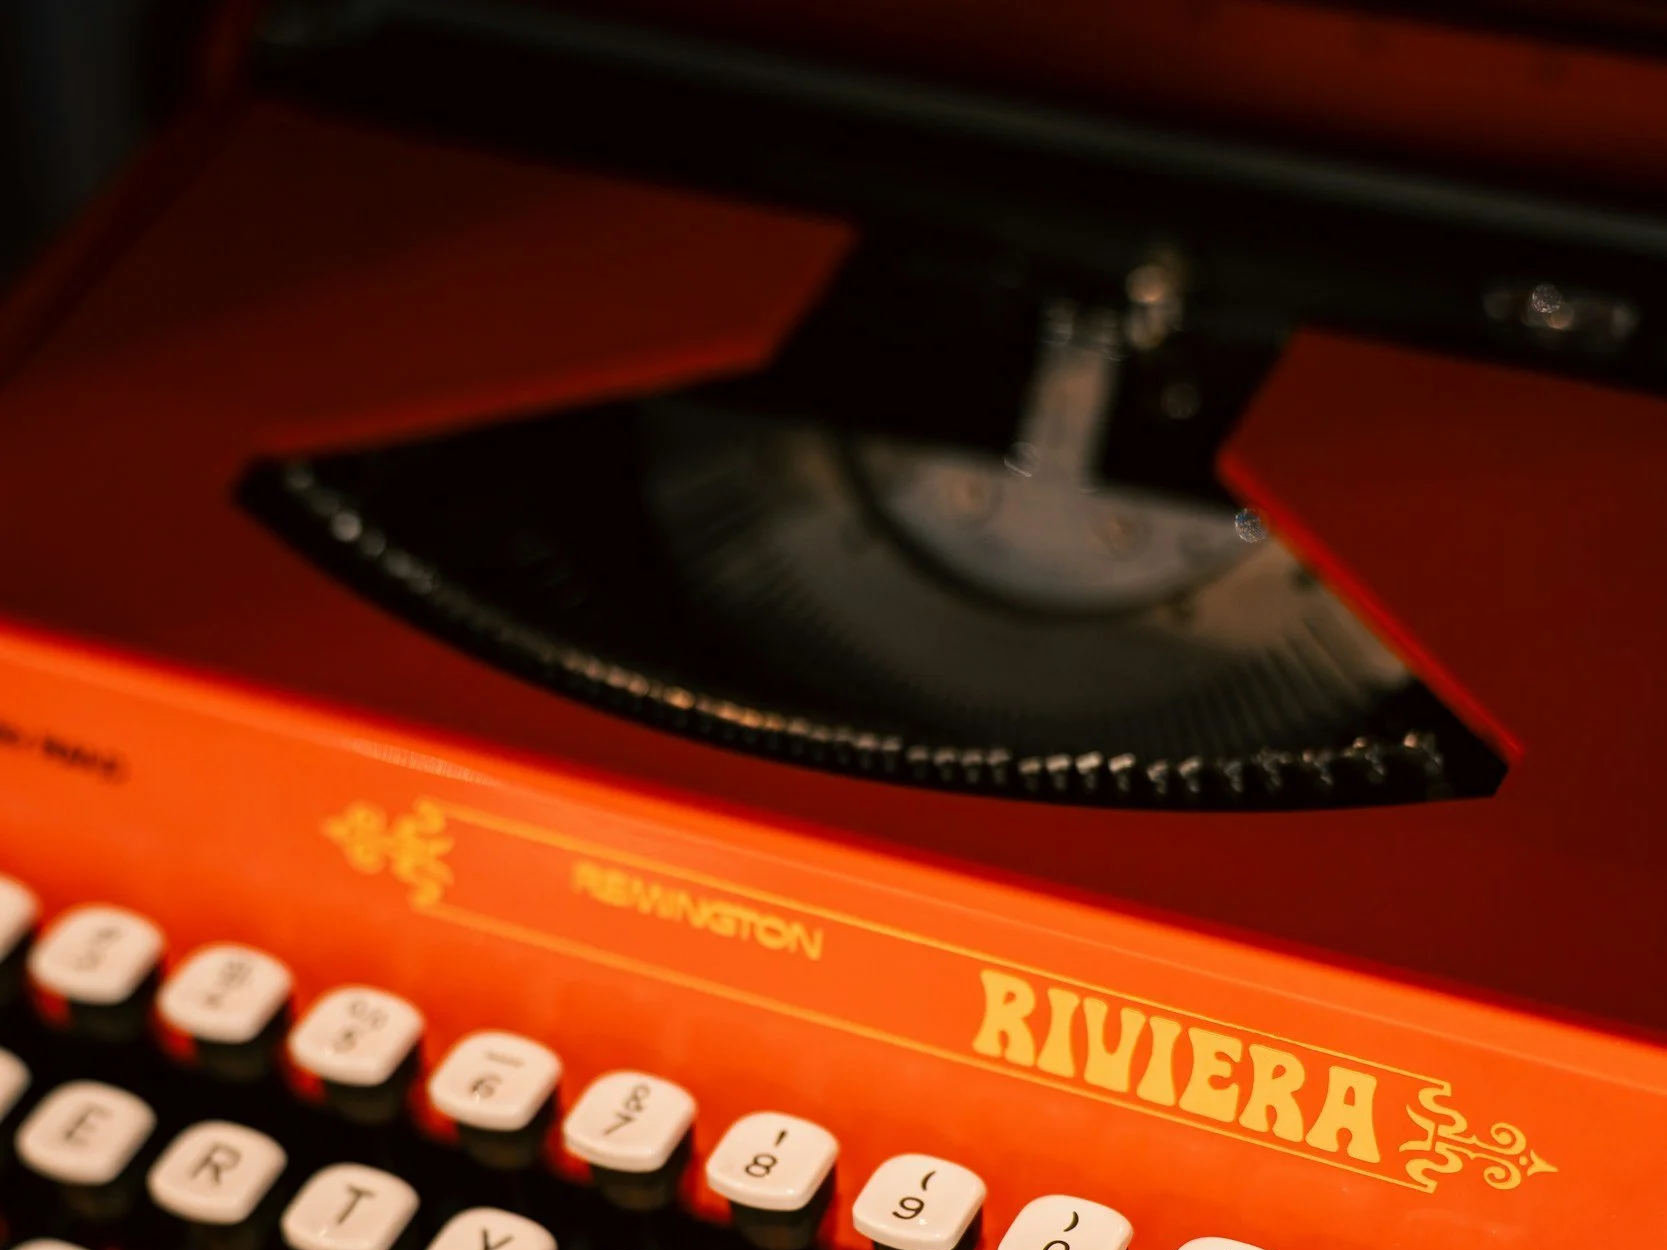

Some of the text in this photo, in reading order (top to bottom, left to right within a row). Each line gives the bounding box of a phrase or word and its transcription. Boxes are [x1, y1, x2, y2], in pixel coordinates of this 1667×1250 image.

[571, 862, 823, 961] REMINGTON
[971, 968, 1381, 1164] RIVIERA
[64, 1102, 112, 1147] E
[190, 1142, 242, 1187] R
[744, 1153, 778, 1178] 8
[336, 1185, 377, 1226] T
[891, 1196, 925, 1220] 9
